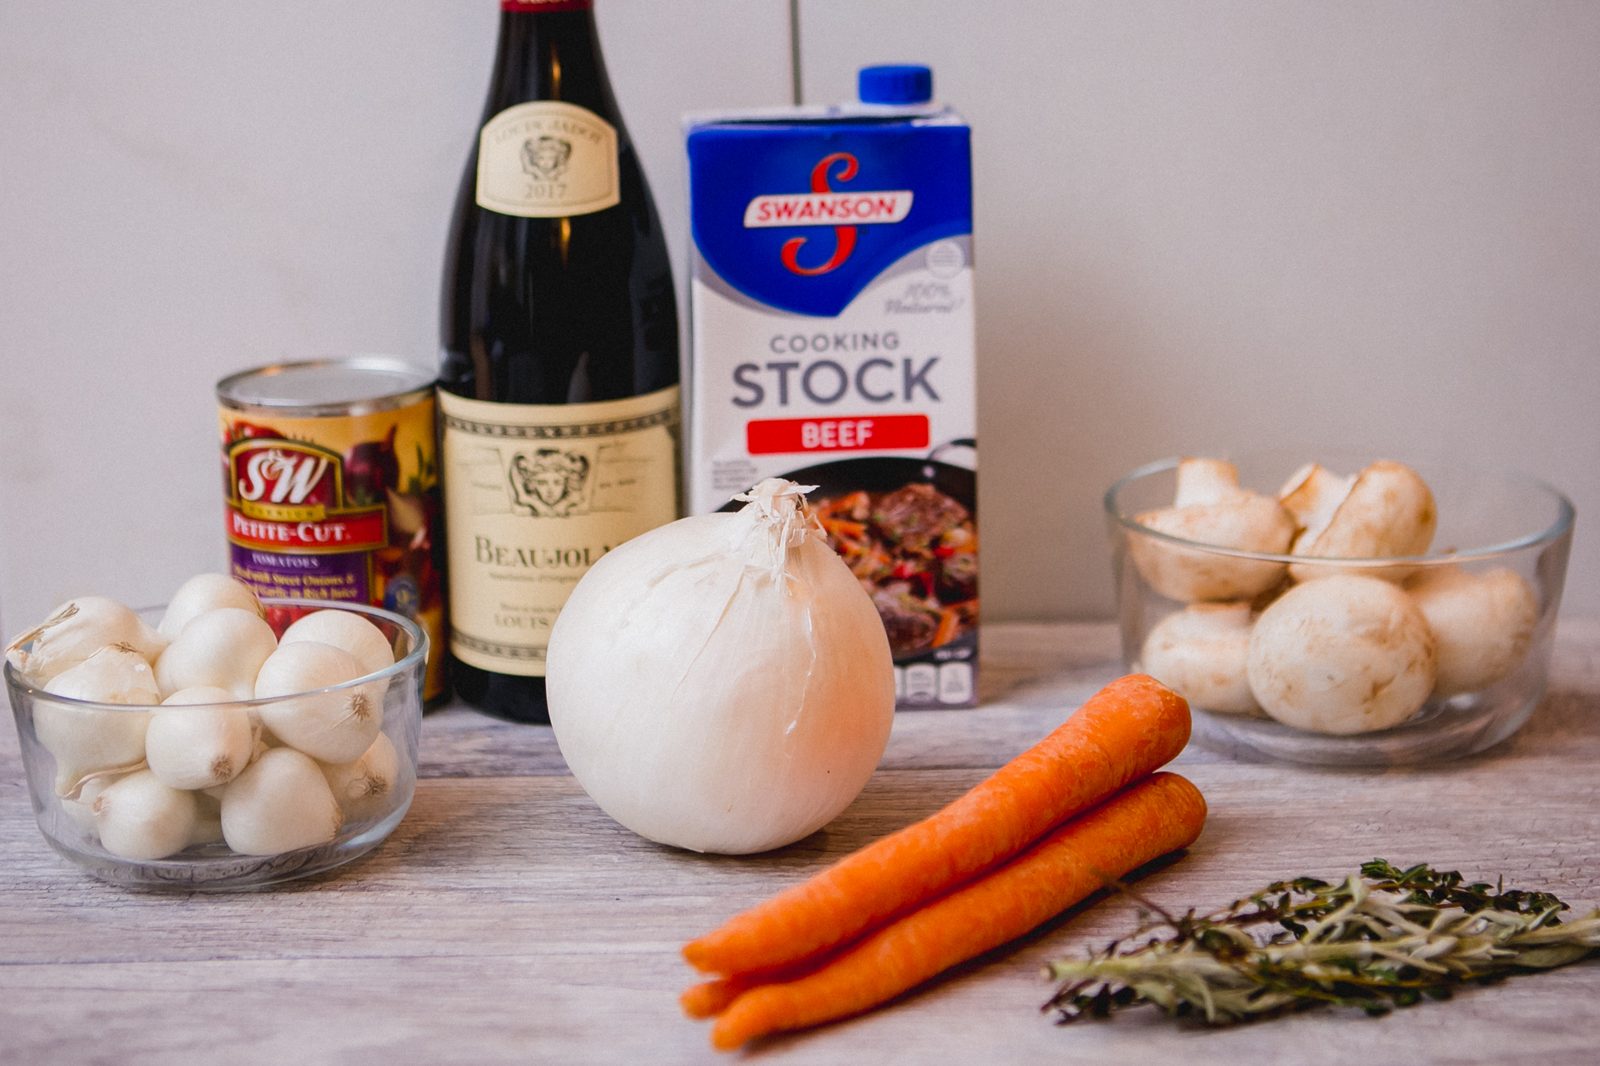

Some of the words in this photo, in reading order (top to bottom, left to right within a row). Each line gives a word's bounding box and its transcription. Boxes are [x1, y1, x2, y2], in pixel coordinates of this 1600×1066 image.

[525, 183, 567, 199] 2017
[757, 197, 897, 221] SWANSON
[770, 332, 899, 353] COOKING
[732, 357, 940, 408] STOCK
[801, 420, 873, 448] BEEF
[239, 449, 329, 504] S&W
[252, 552, 319, 569] TOMATOES
[475, 535, 611, 569] BEAUJOL
[494, 613, 549, 630] LOUIS
